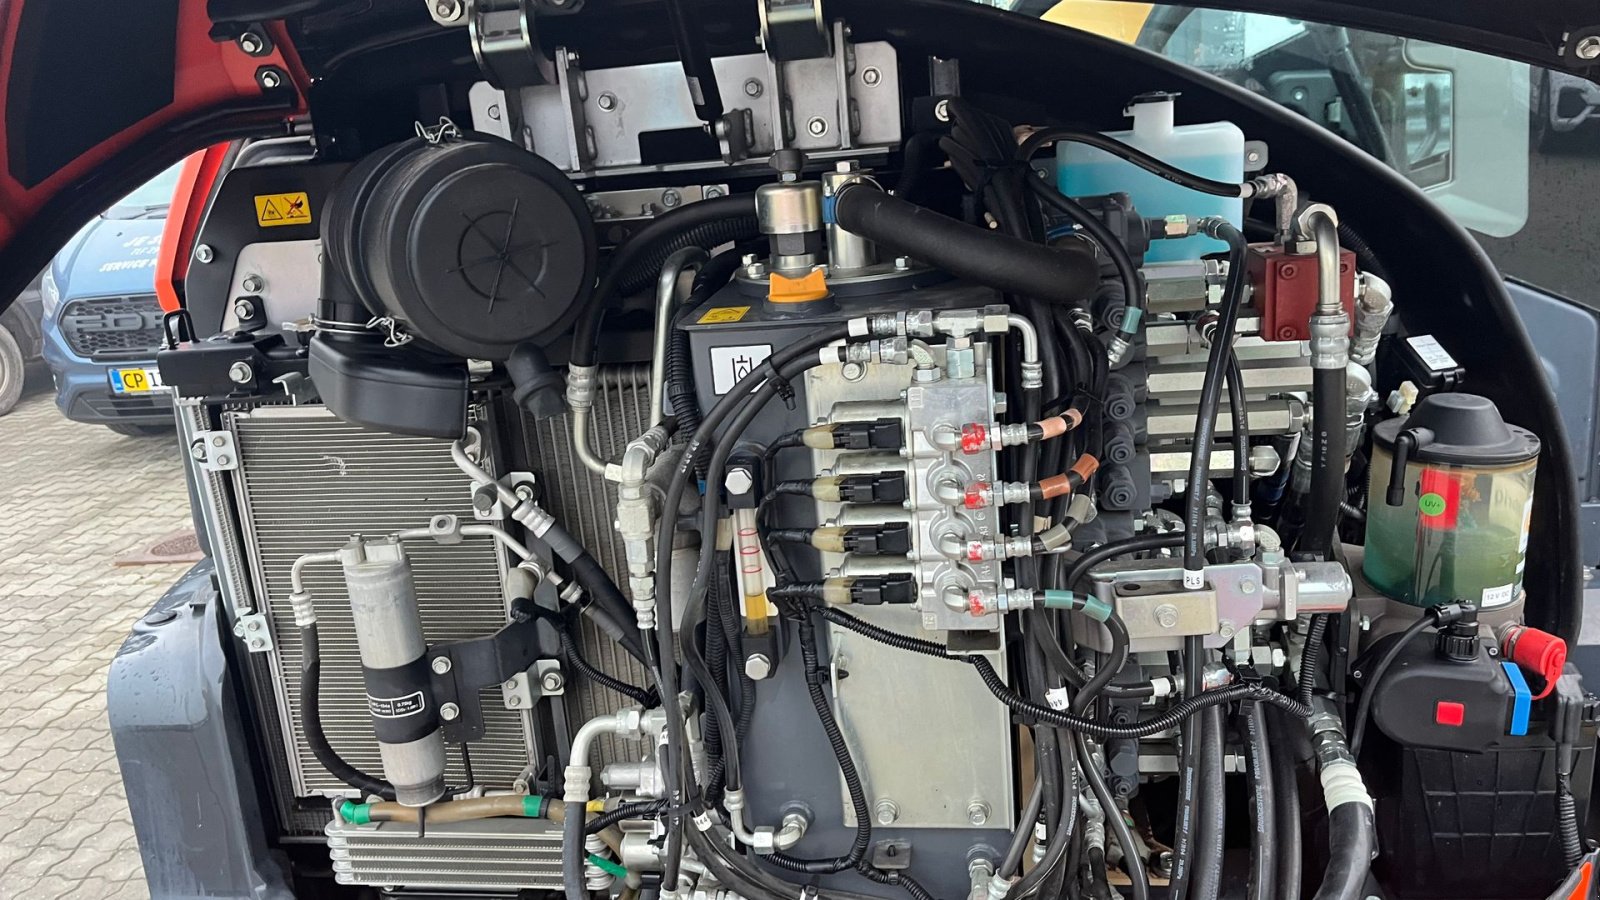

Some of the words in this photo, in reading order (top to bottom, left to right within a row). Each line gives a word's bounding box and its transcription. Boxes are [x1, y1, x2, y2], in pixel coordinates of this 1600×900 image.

[99, 260, 147, 272] SERVICE
[123, 373, 143, 389] CP
[1185, 573, 1201, 586] PLS
[1487, 593, 1494, 601] 12
[1256, 785, 1264, 833] BRIDGESTONE
